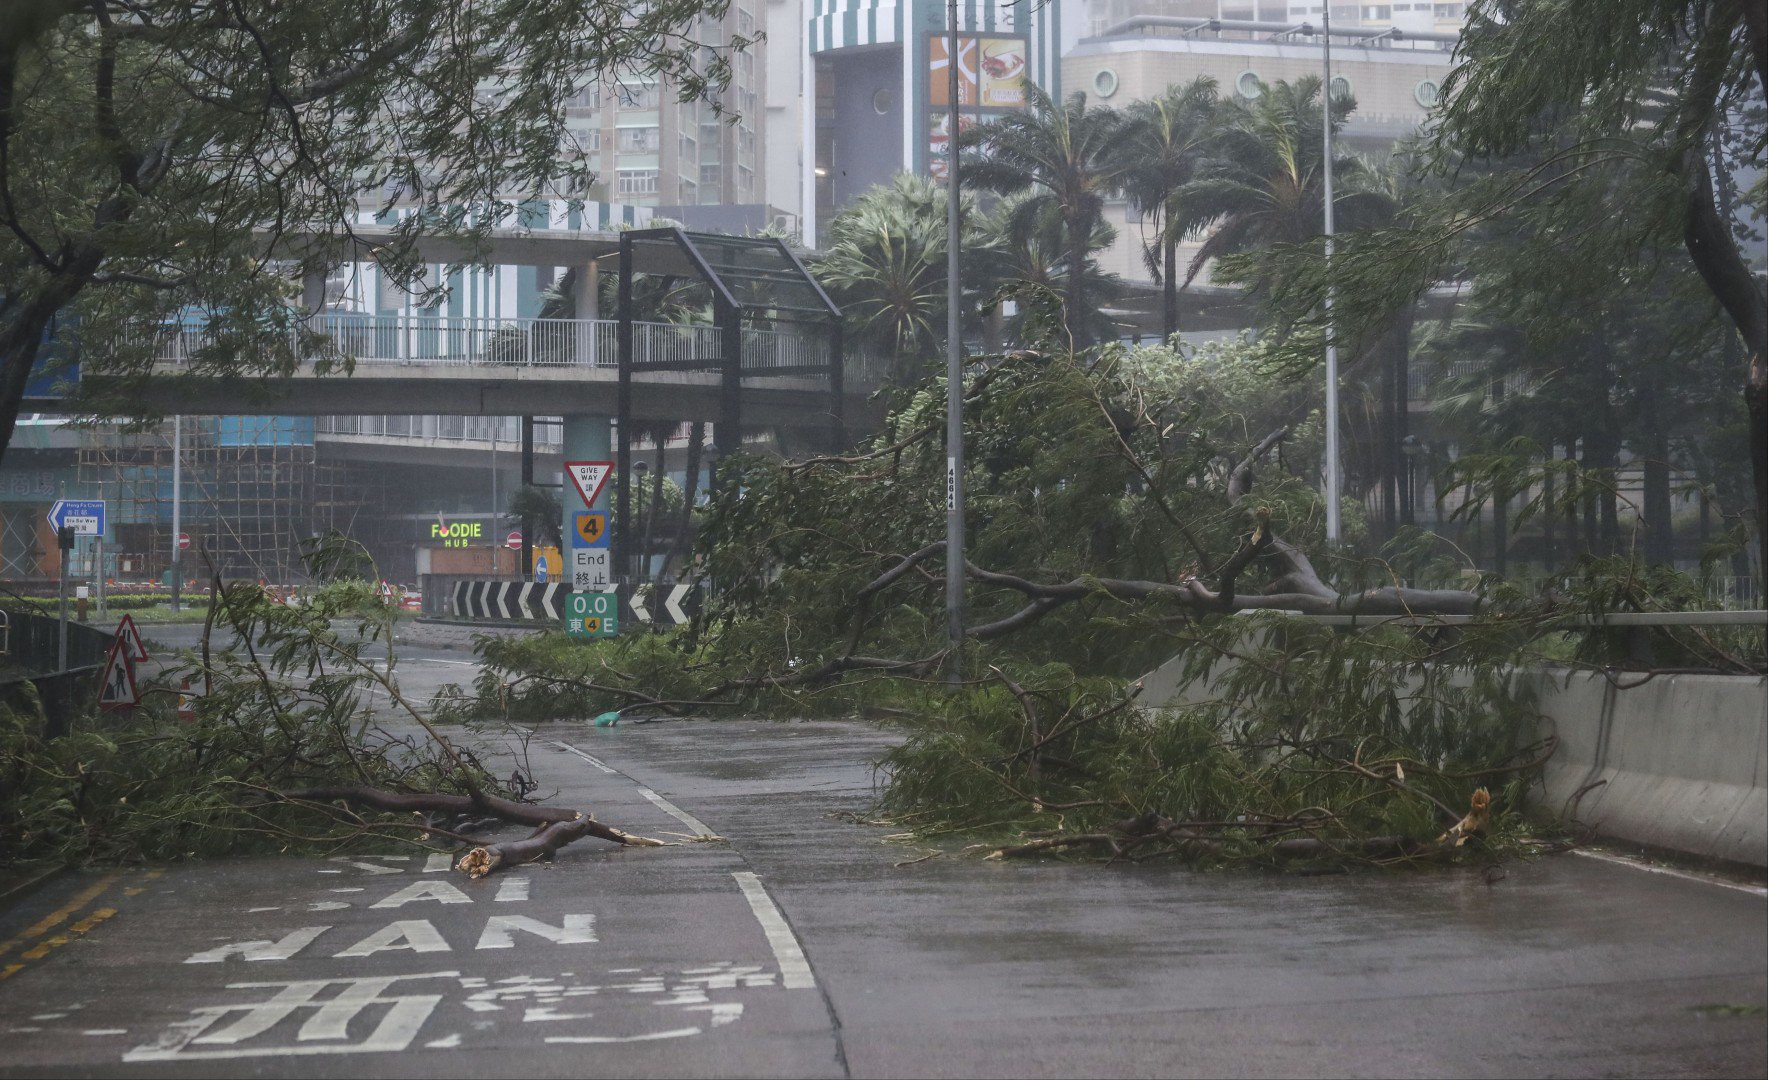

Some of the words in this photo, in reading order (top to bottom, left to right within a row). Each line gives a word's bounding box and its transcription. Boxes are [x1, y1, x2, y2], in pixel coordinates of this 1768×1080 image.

[0, 471, 55, 496] 商場
[431, 523, 482, 538] FOODIE
[583, 518, 598, 536] 4
[445, 539, 469, 548] HUB
[577, 553, 605, 565] End
[575, 571, 607, 585] 終止
[573, 596, 607, 614] 0.0
[569, 618, 583, 633] 東
[587, 619, 597, 630] 4
[603, 617, 614, 632] E
